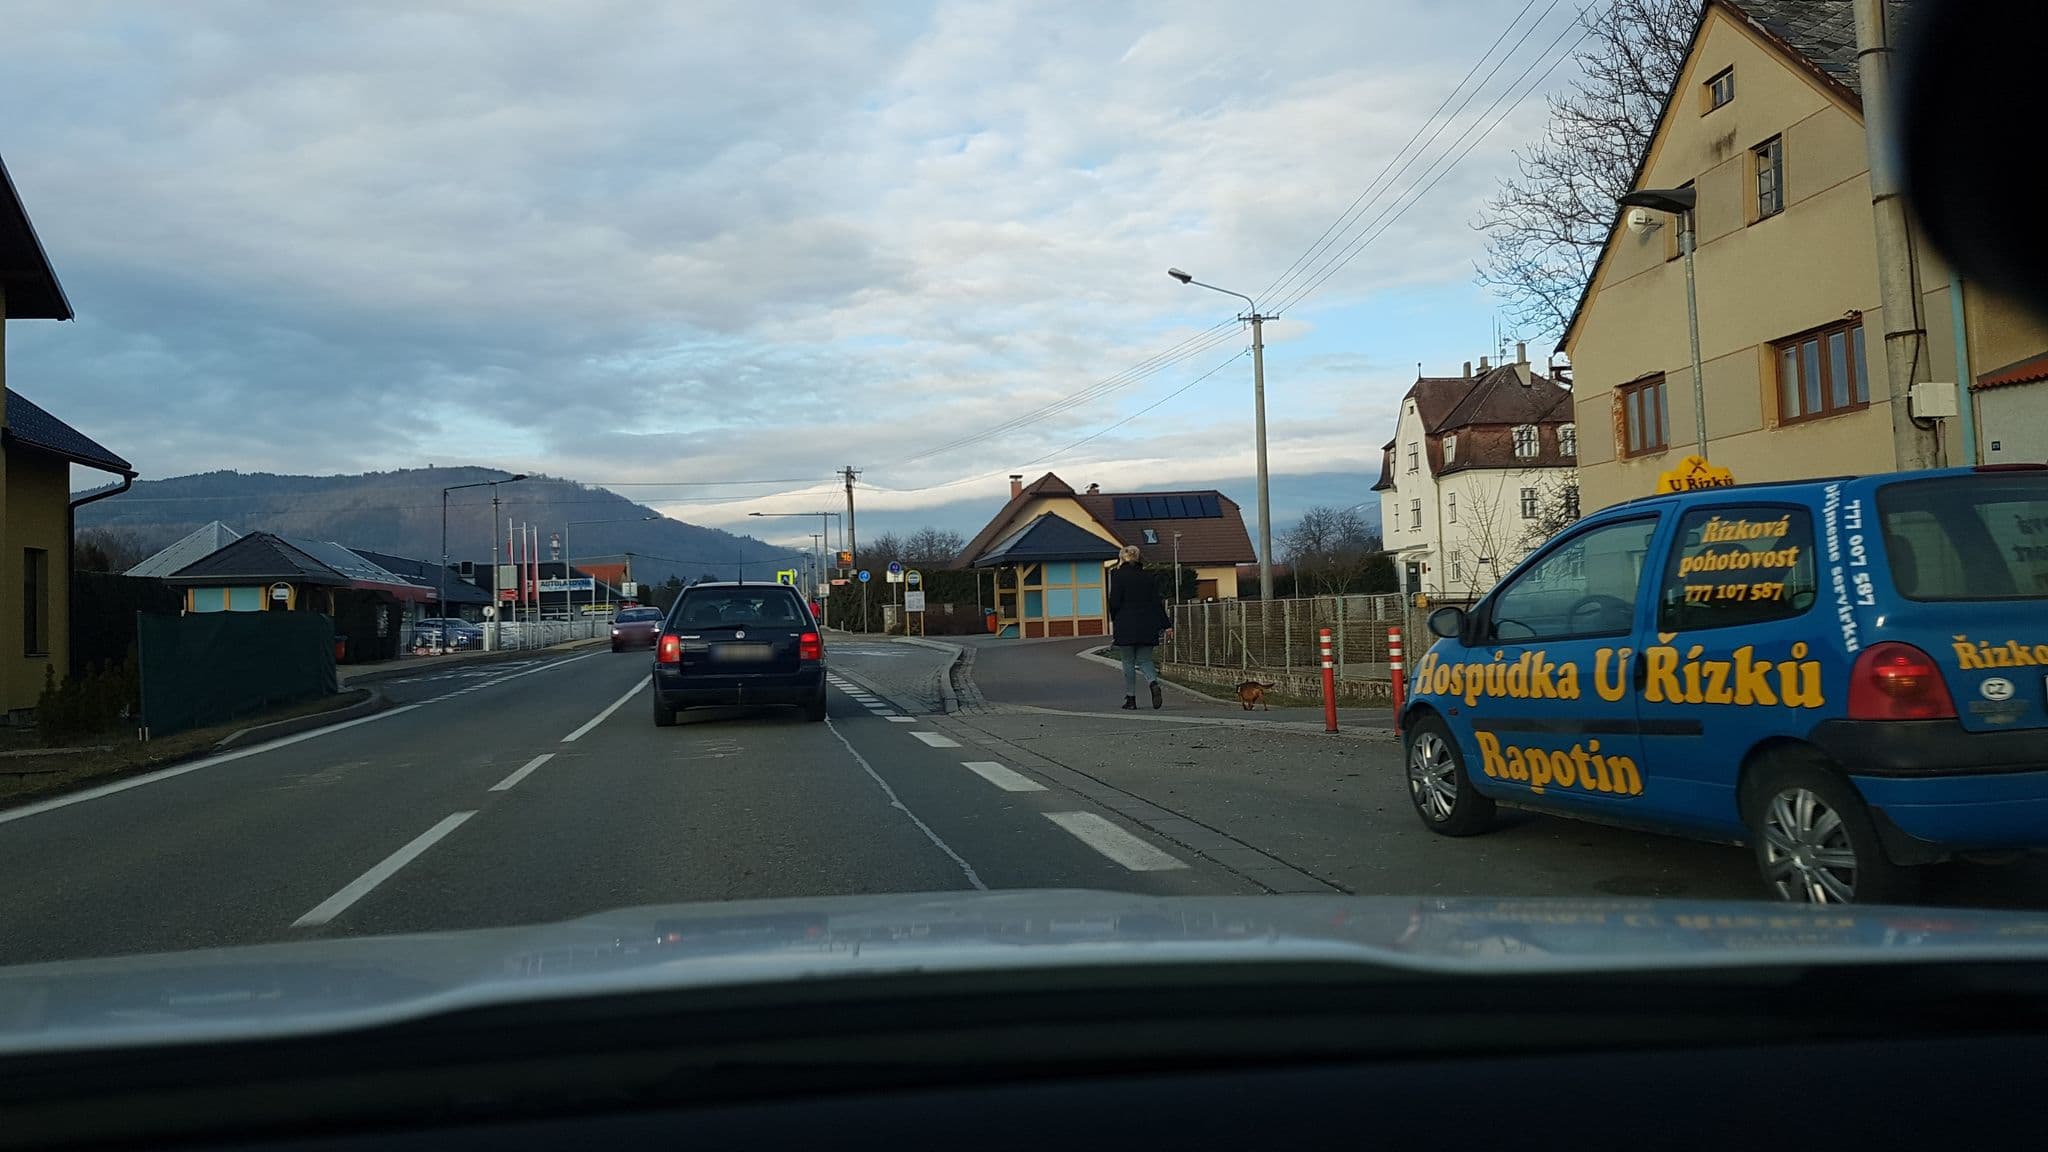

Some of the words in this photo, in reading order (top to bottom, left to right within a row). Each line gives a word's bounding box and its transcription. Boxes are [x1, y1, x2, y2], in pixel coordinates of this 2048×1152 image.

[1669, 479, 1682, 491] U
[1702, 514, 1791, 543] Řízková
[1844, 500, 1862, 529] 777
[1677, 545, 1800, 578] pohotovost
[1848, 535, 1867, 566] 007
[1684, 584, 1714, 602] 777
[1715, 583, 1748, 601] 107
[1750, 582, 1784, 601] 587
[1852, 573, 1875, 605] 587
[1414, 649, 1581, 708] Hospůdka
[1594, 647, 1633, 702] U
[1644, 632, 1826, 709] Řízků
[1986, 682, 2008, 696] CZ
